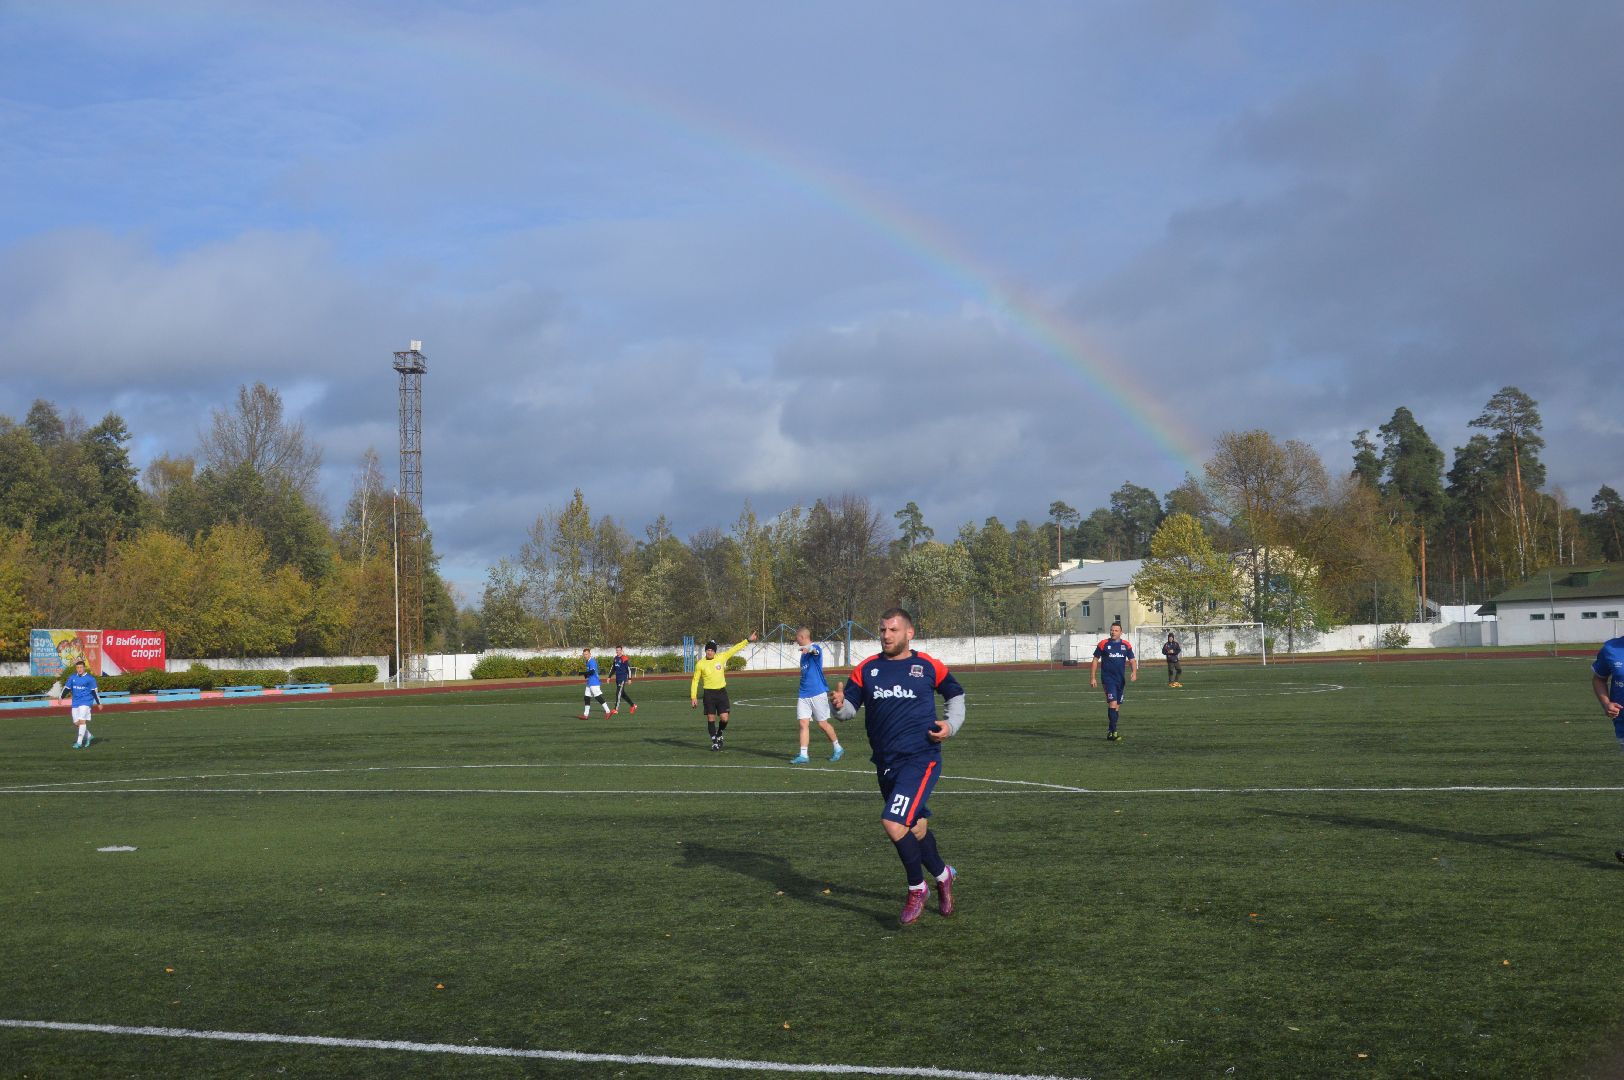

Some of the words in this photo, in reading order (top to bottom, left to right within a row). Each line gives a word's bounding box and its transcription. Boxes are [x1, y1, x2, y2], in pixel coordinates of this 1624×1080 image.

[106, 635, 114, 645] Я
[116, 635, 162, 649] выбираю
[131, 648, 162, 659] спорт!
[890, 794, 910, 816] 21
